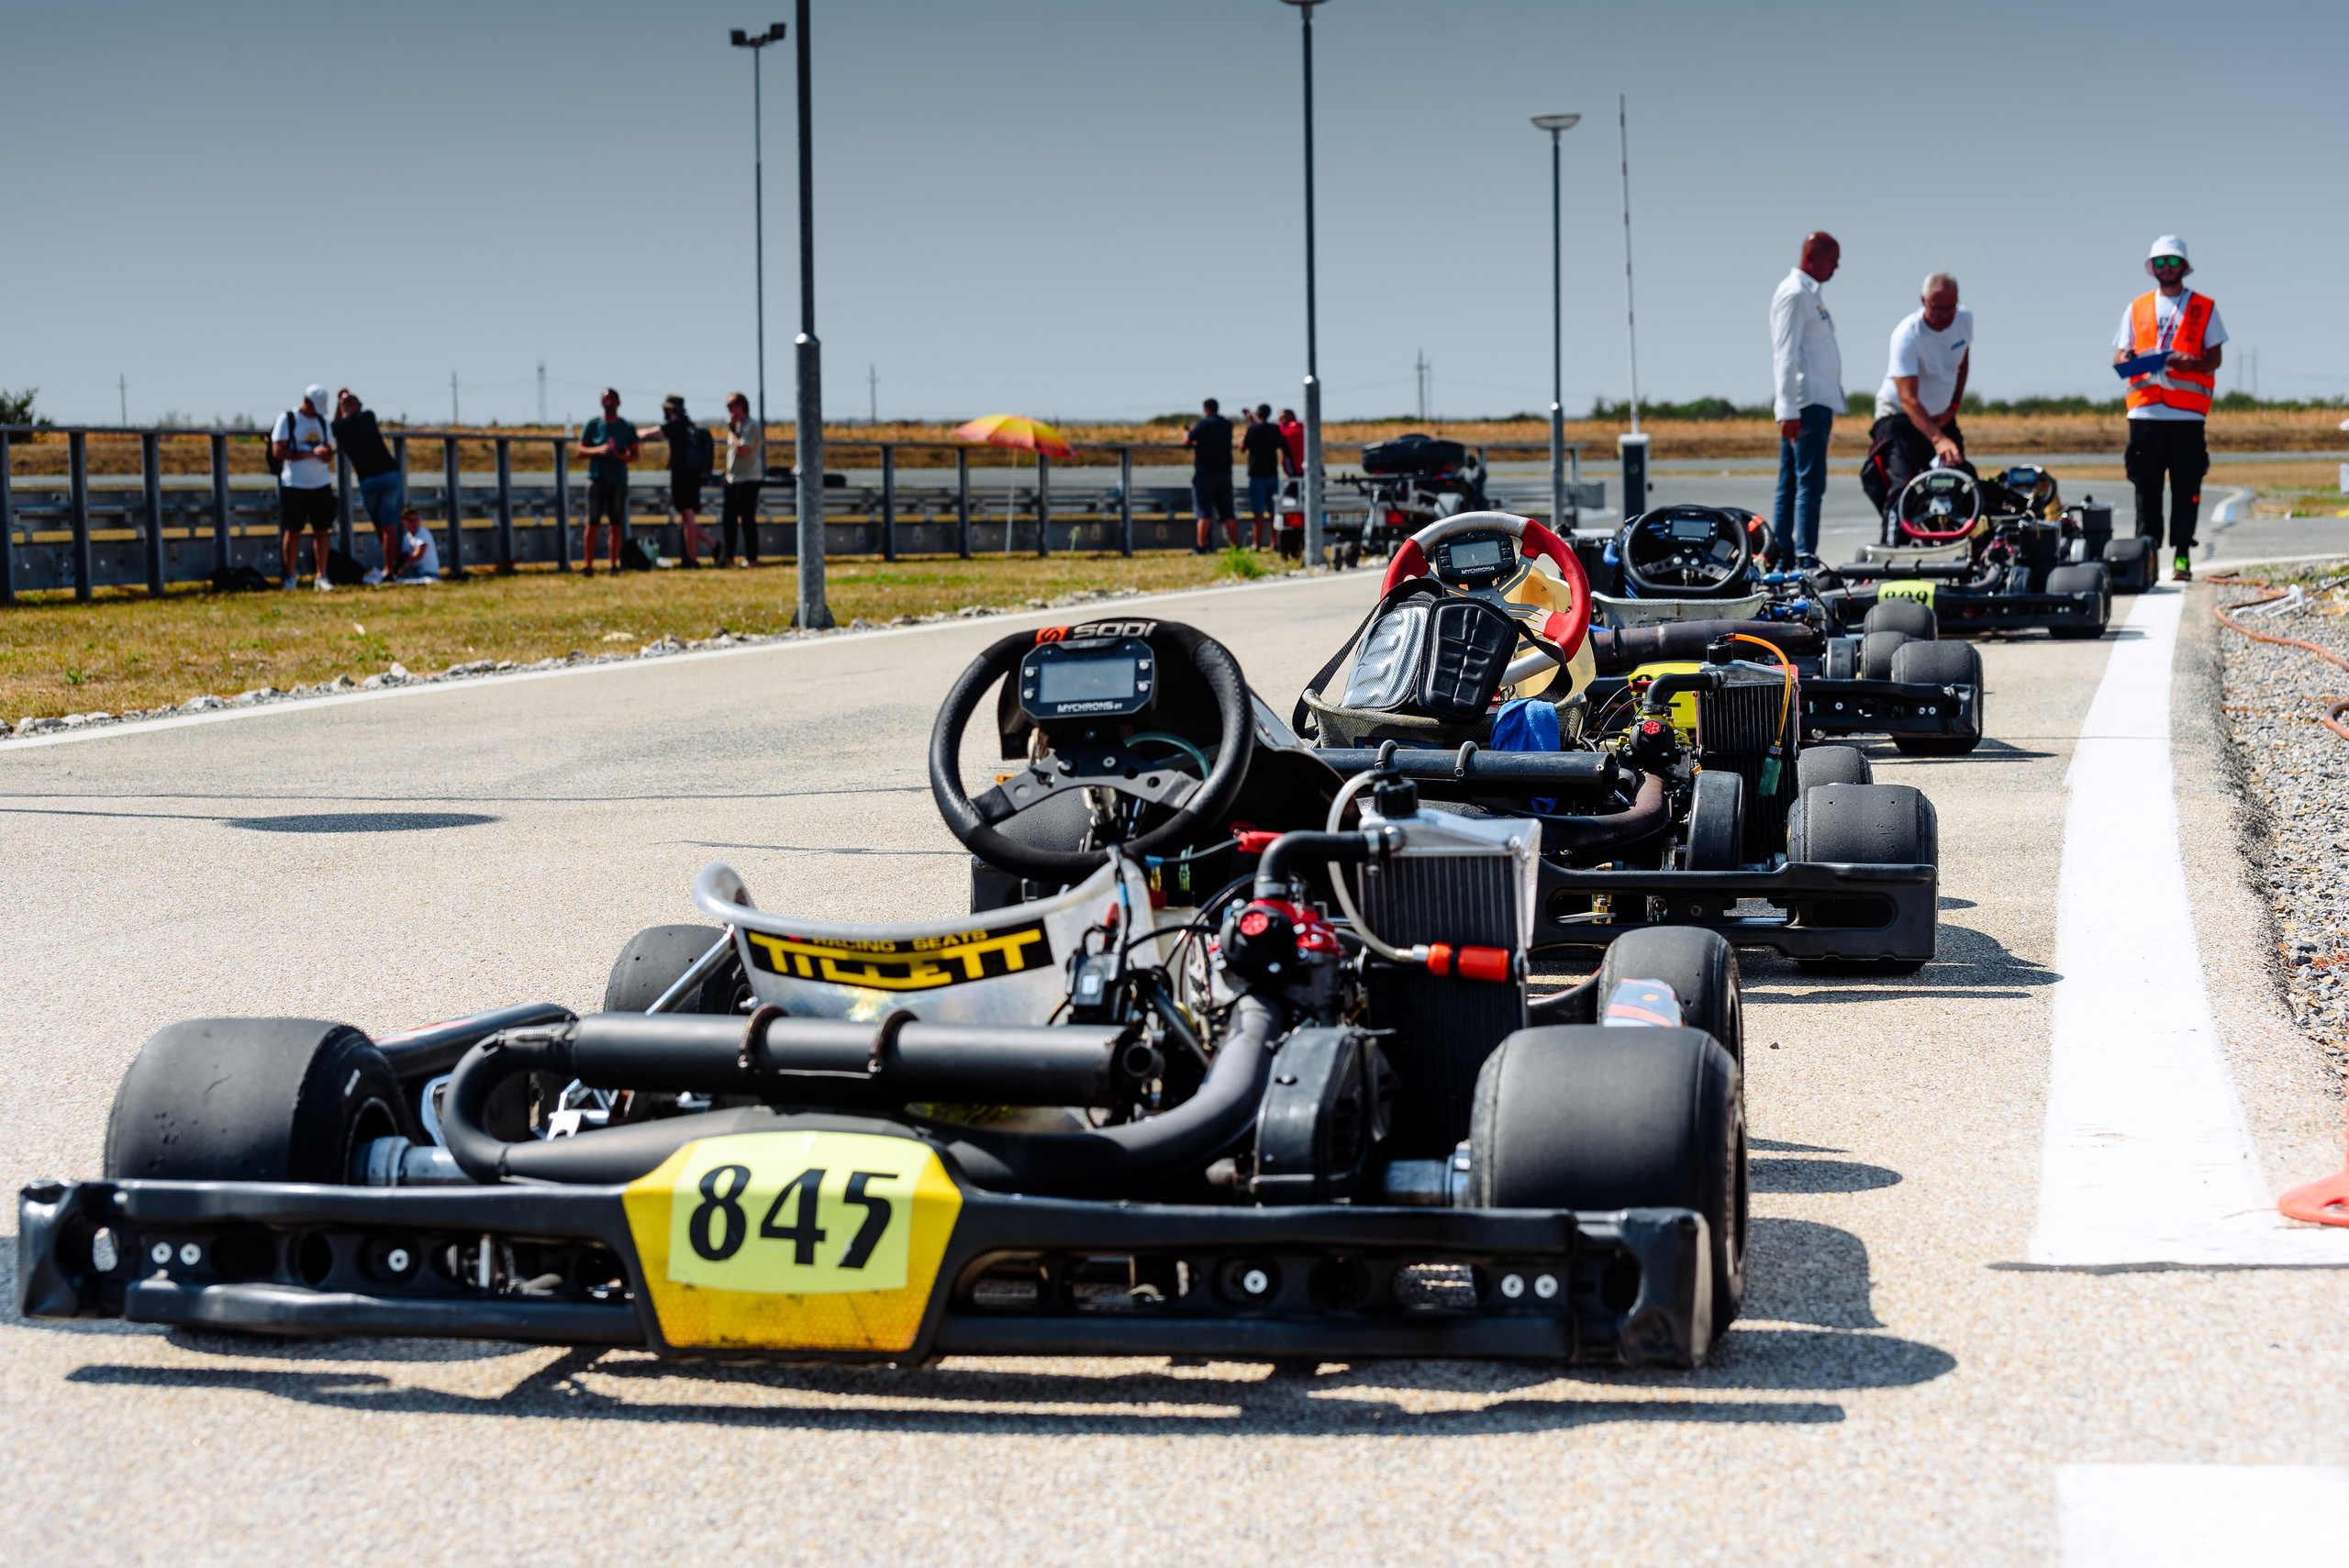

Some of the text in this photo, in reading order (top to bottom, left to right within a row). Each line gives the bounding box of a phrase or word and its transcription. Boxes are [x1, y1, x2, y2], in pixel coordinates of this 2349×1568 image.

[748, 929, 1042, 990] TILLETT
[912, 929, 988, 951] SEATS
[689, 1164, 899, 1270] 845
